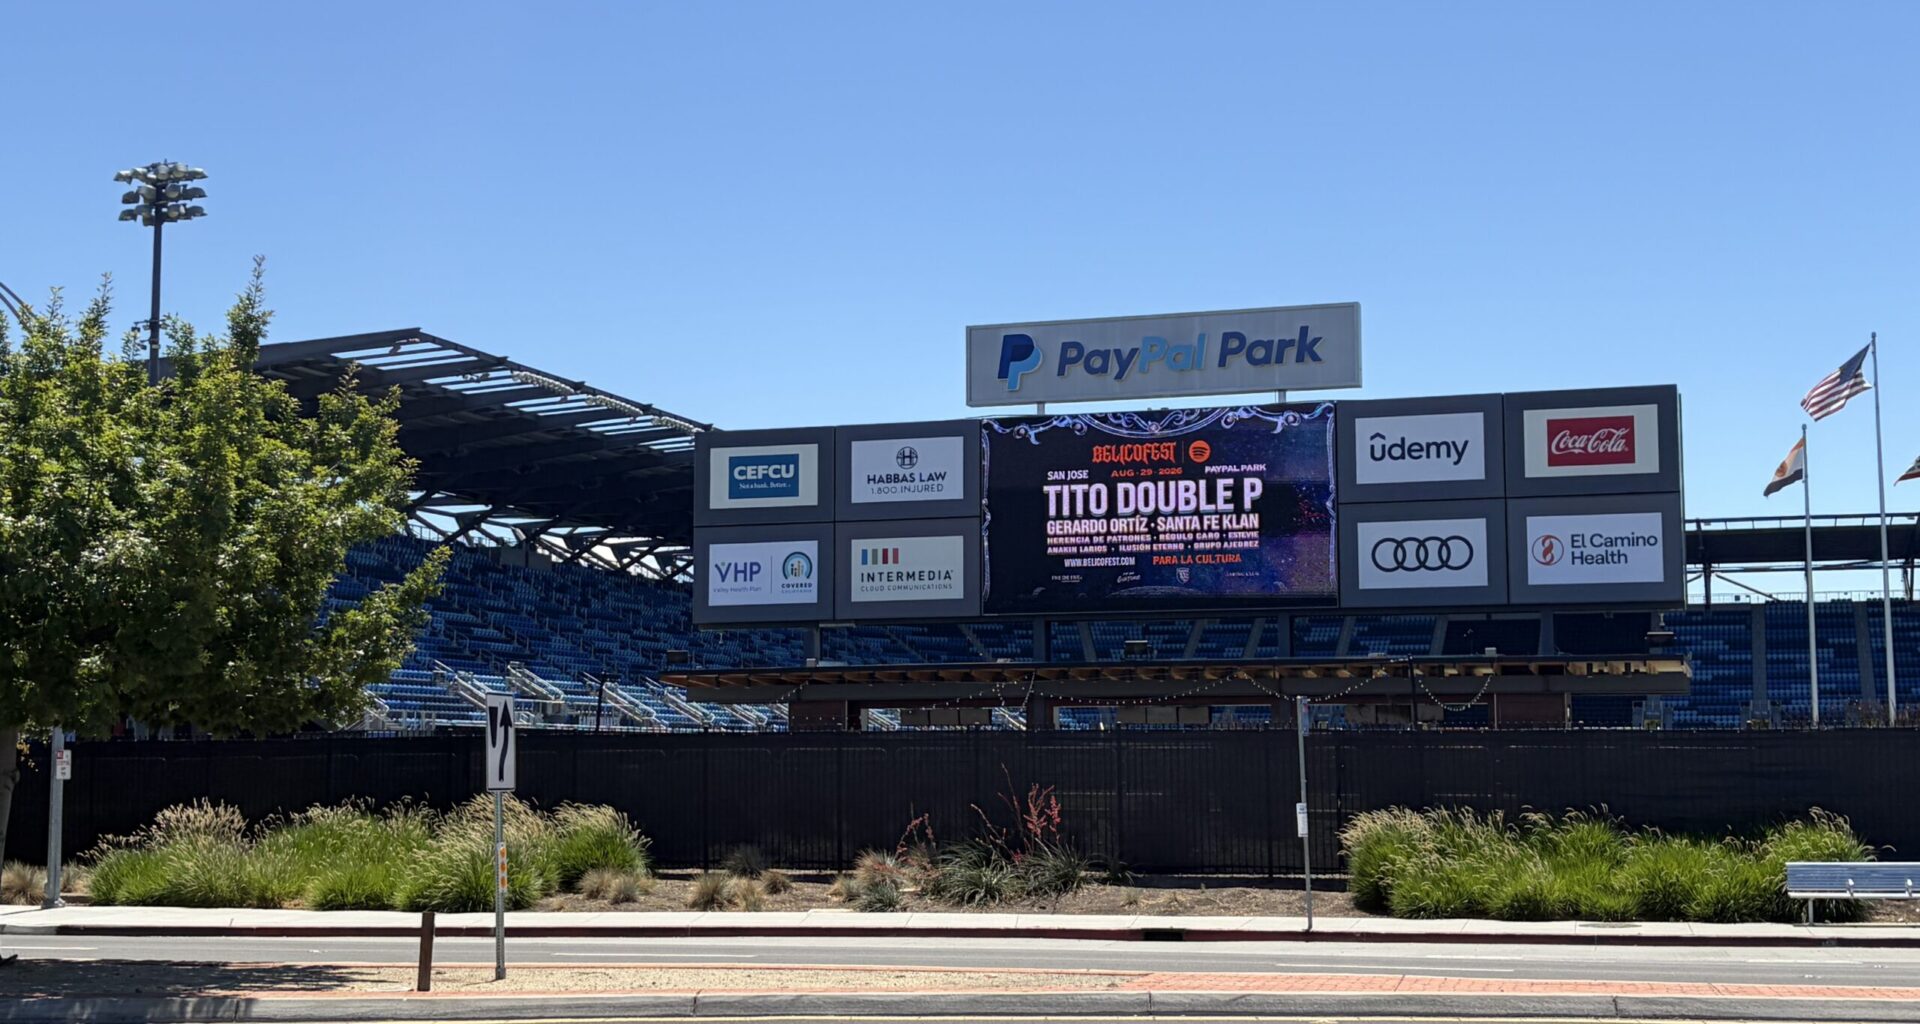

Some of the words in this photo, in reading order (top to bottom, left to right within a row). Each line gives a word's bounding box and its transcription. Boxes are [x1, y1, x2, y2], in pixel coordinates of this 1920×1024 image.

[1057, 333, 1207, 381] PayPal
[1218, 325, 1324, 367] Park
[1551, 427, 1630, 455] Coca-Cola
[1092, 441, 1177, 465] BELICOFEST
[733, 464, 795, 480] CEFCU
[1047, 471, 1065, 480] SAN
[1067, 470, 1089, 480] JOSE
[1111, 469, 1134, 477] AUG
[1140, 468, 1153, 476] 29
[1158, 467, 1183, 475] 2026
[1204, 465, 1239, 474] PAYPAL
[1240, 463, 1267, 472] PARK
[867, 472, 916, 484] HABBAS
[919, 471, 947, 482] LAW
[900, 483, 944, 493] INJURED
[1043, 483, 1108, 518] TITO
[1117, 478, 1234, 517] DOUBLE
[1243, 477, 1263, 512] P
[1046, 519, 1107, 535] GERARDO
[1157, 515, 1200, 532] SANTA
[1203, 514, 1220, 530] FE
[1222, 513, 1259, 530] KLAN
[1047, 536, 1090, 545] HERENCIA
[1093, 535, 1105, 543] DE
[1106, 534, 1151, 543] PATRONES
[1196, 532, 1220, 540] CARO
[1571, 534, 1587, 549] El
[1591, 532, 1658, 548] Camino
[1047, 546, 1077, 554] ANAKIN
[1079, 545, 1107, 553] LARIOS
[1152, 543, 1184, 551] ETERNO
[1193, 541, 1221, 549] GRUPO
[1223, 540, 1259, 548] AJEDREZ
[1064, 556, 1136, 567] WWW.BELICOFEST.COM
[1152, 555, 1178, 565] PARA
[1180, 554, 1193, 564] LA
[1195, 553, 1242, 563] CULTURA
[1571, 550, 1628, 565] Health
[715, 562, 761, 582] VHP
[887, 583, 953, 591] COMMUNICATIONS
